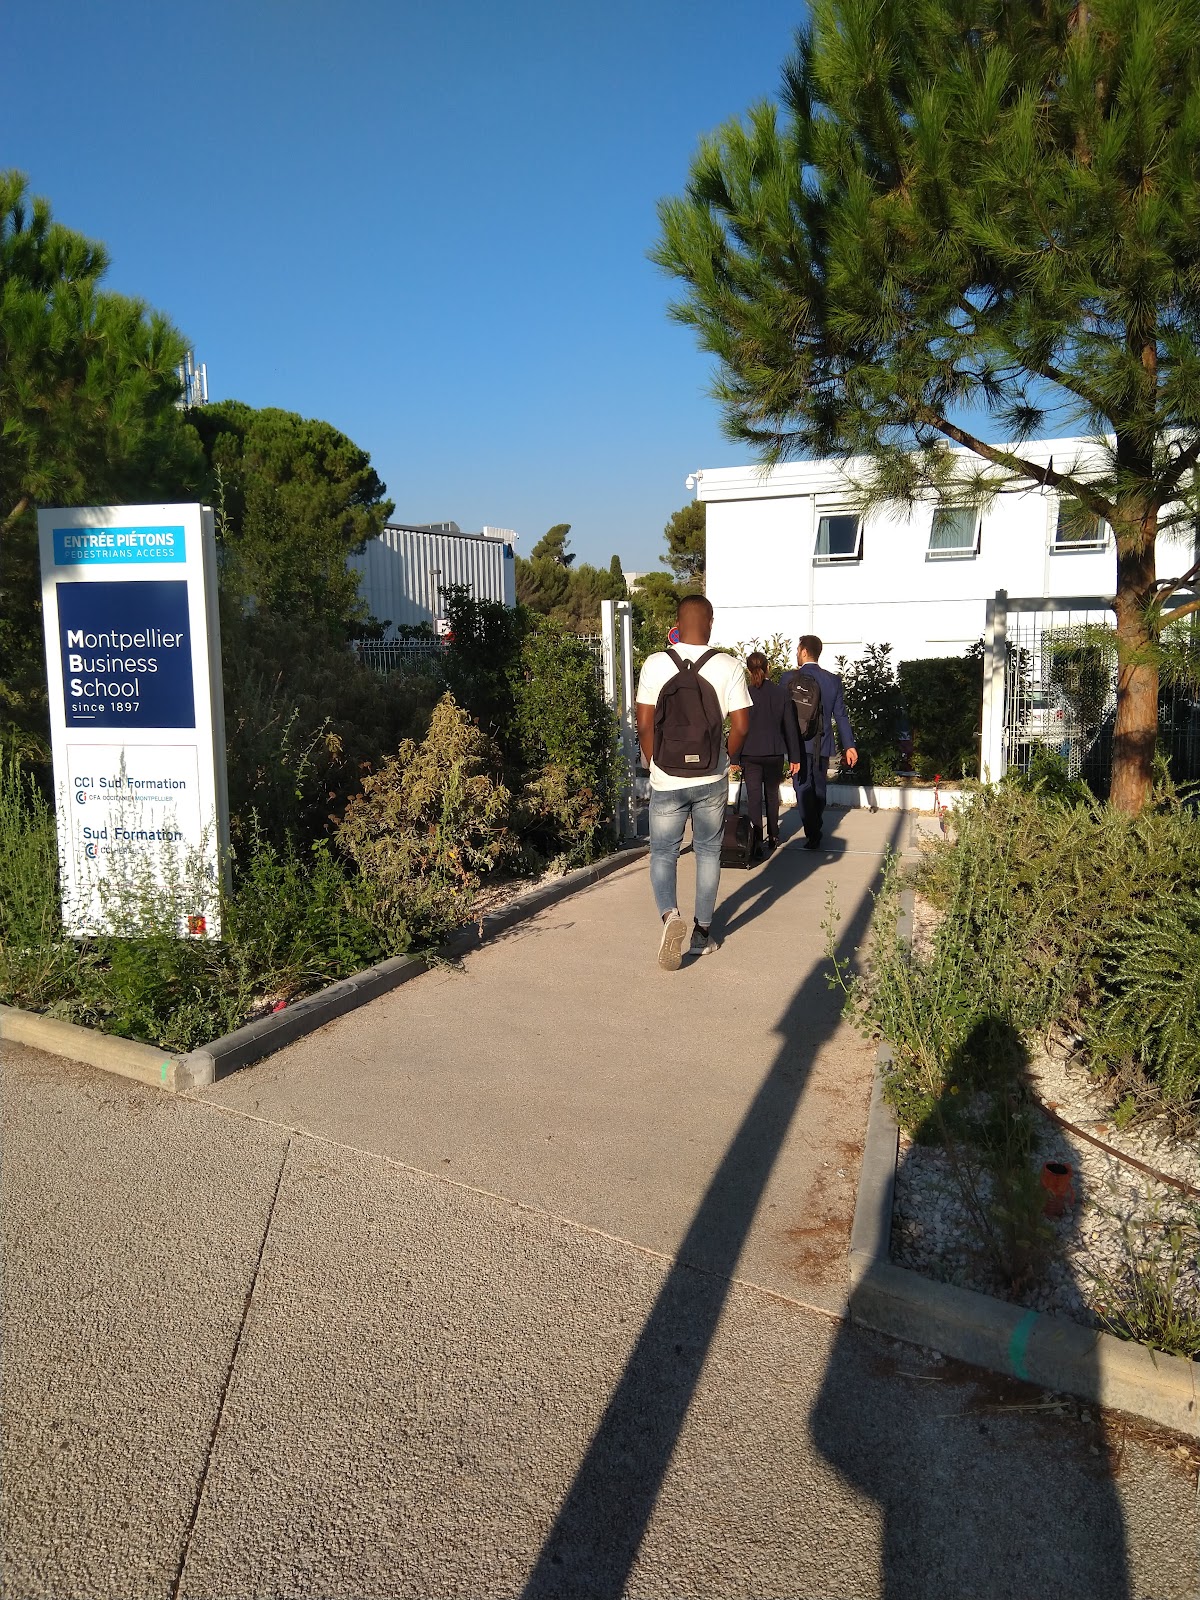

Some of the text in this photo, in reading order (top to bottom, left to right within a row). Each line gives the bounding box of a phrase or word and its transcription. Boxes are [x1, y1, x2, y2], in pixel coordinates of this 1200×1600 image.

[64, 531, 174, 548] ENTRÉE PIÉTONS
[65, 548, 174, 558] PEDESTRIANS ACCESS
[67, 629, 183, 651] Montpellier
[69, 654, 158, 673] Business
[70, 678, 139, 697] School
[72, 702, 139, 712] since 1897
[74, 777, 186, 788] CCI Sud Formation
[83, 827, 182, 841] Sud Formation
